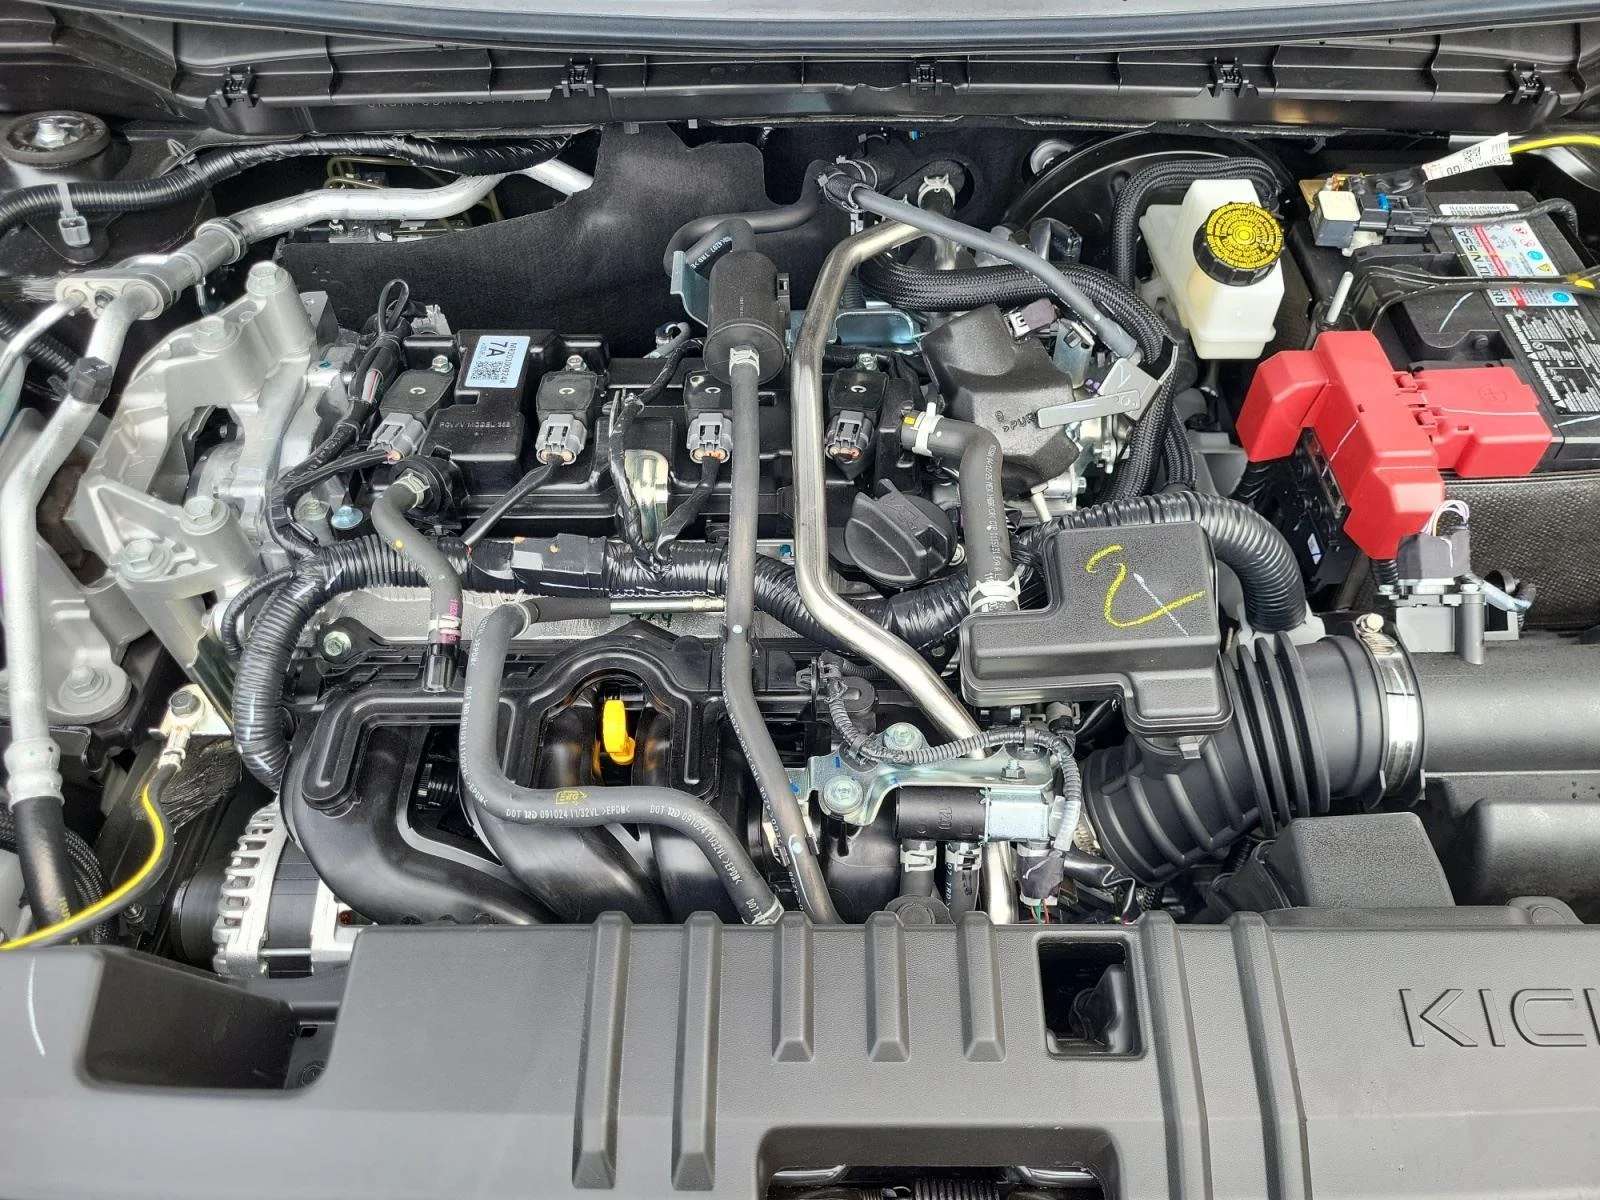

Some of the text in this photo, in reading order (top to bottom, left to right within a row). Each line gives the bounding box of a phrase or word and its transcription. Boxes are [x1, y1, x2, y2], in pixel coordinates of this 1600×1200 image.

[486, 341, 509, 357] 7A
[558, 386, 575, 395] C
[506, 808, 522, 819] DOT
[540, 808, 568, 820] 091024
[650, 804, 666, 815] DOT
